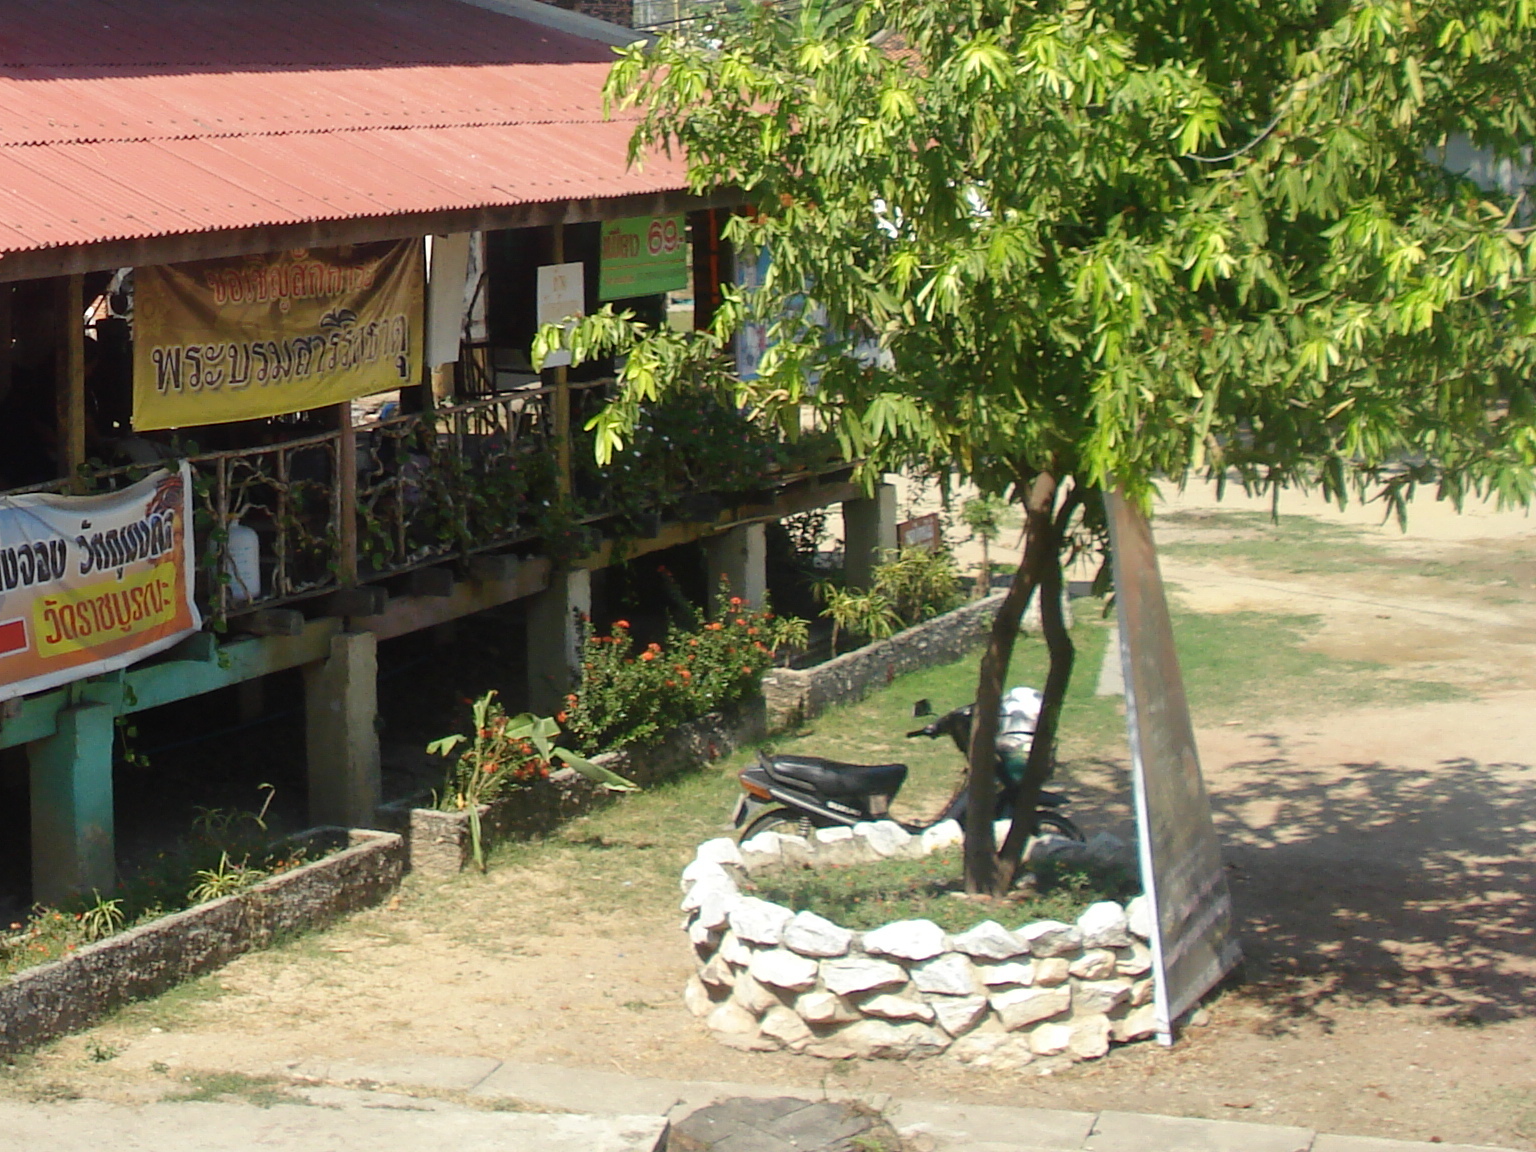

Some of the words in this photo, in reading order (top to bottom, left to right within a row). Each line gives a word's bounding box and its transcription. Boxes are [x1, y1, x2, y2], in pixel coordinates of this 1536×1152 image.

[43, 578, 170, 645] วัดราชบูรณะ
